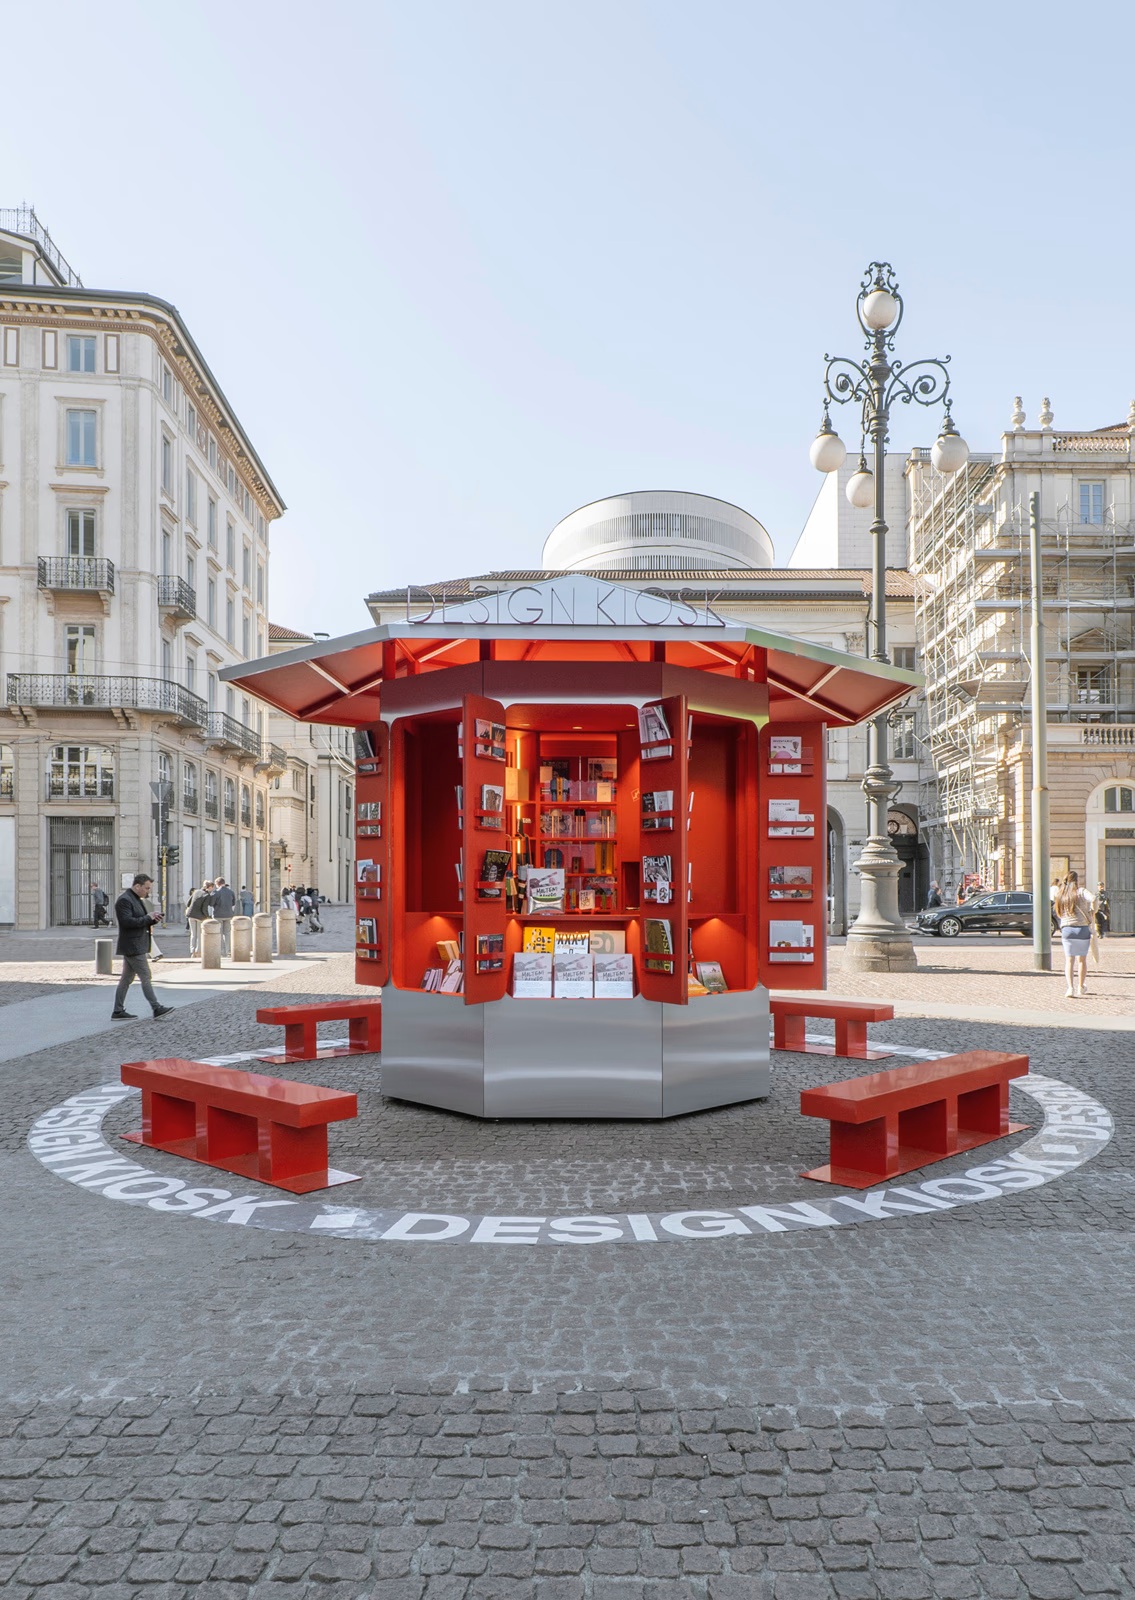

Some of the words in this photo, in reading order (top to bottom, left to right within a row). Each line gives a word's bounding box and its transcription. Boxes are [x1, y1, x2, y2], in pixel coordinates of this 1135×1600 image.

[29, 1095, 126, 1163] DESIGN
[52, 1157, 299, 1225] KIOSK
[379, 1201, 841, 1245] DESIGN
[832, 1151, 1080, 1218] KIOSK
